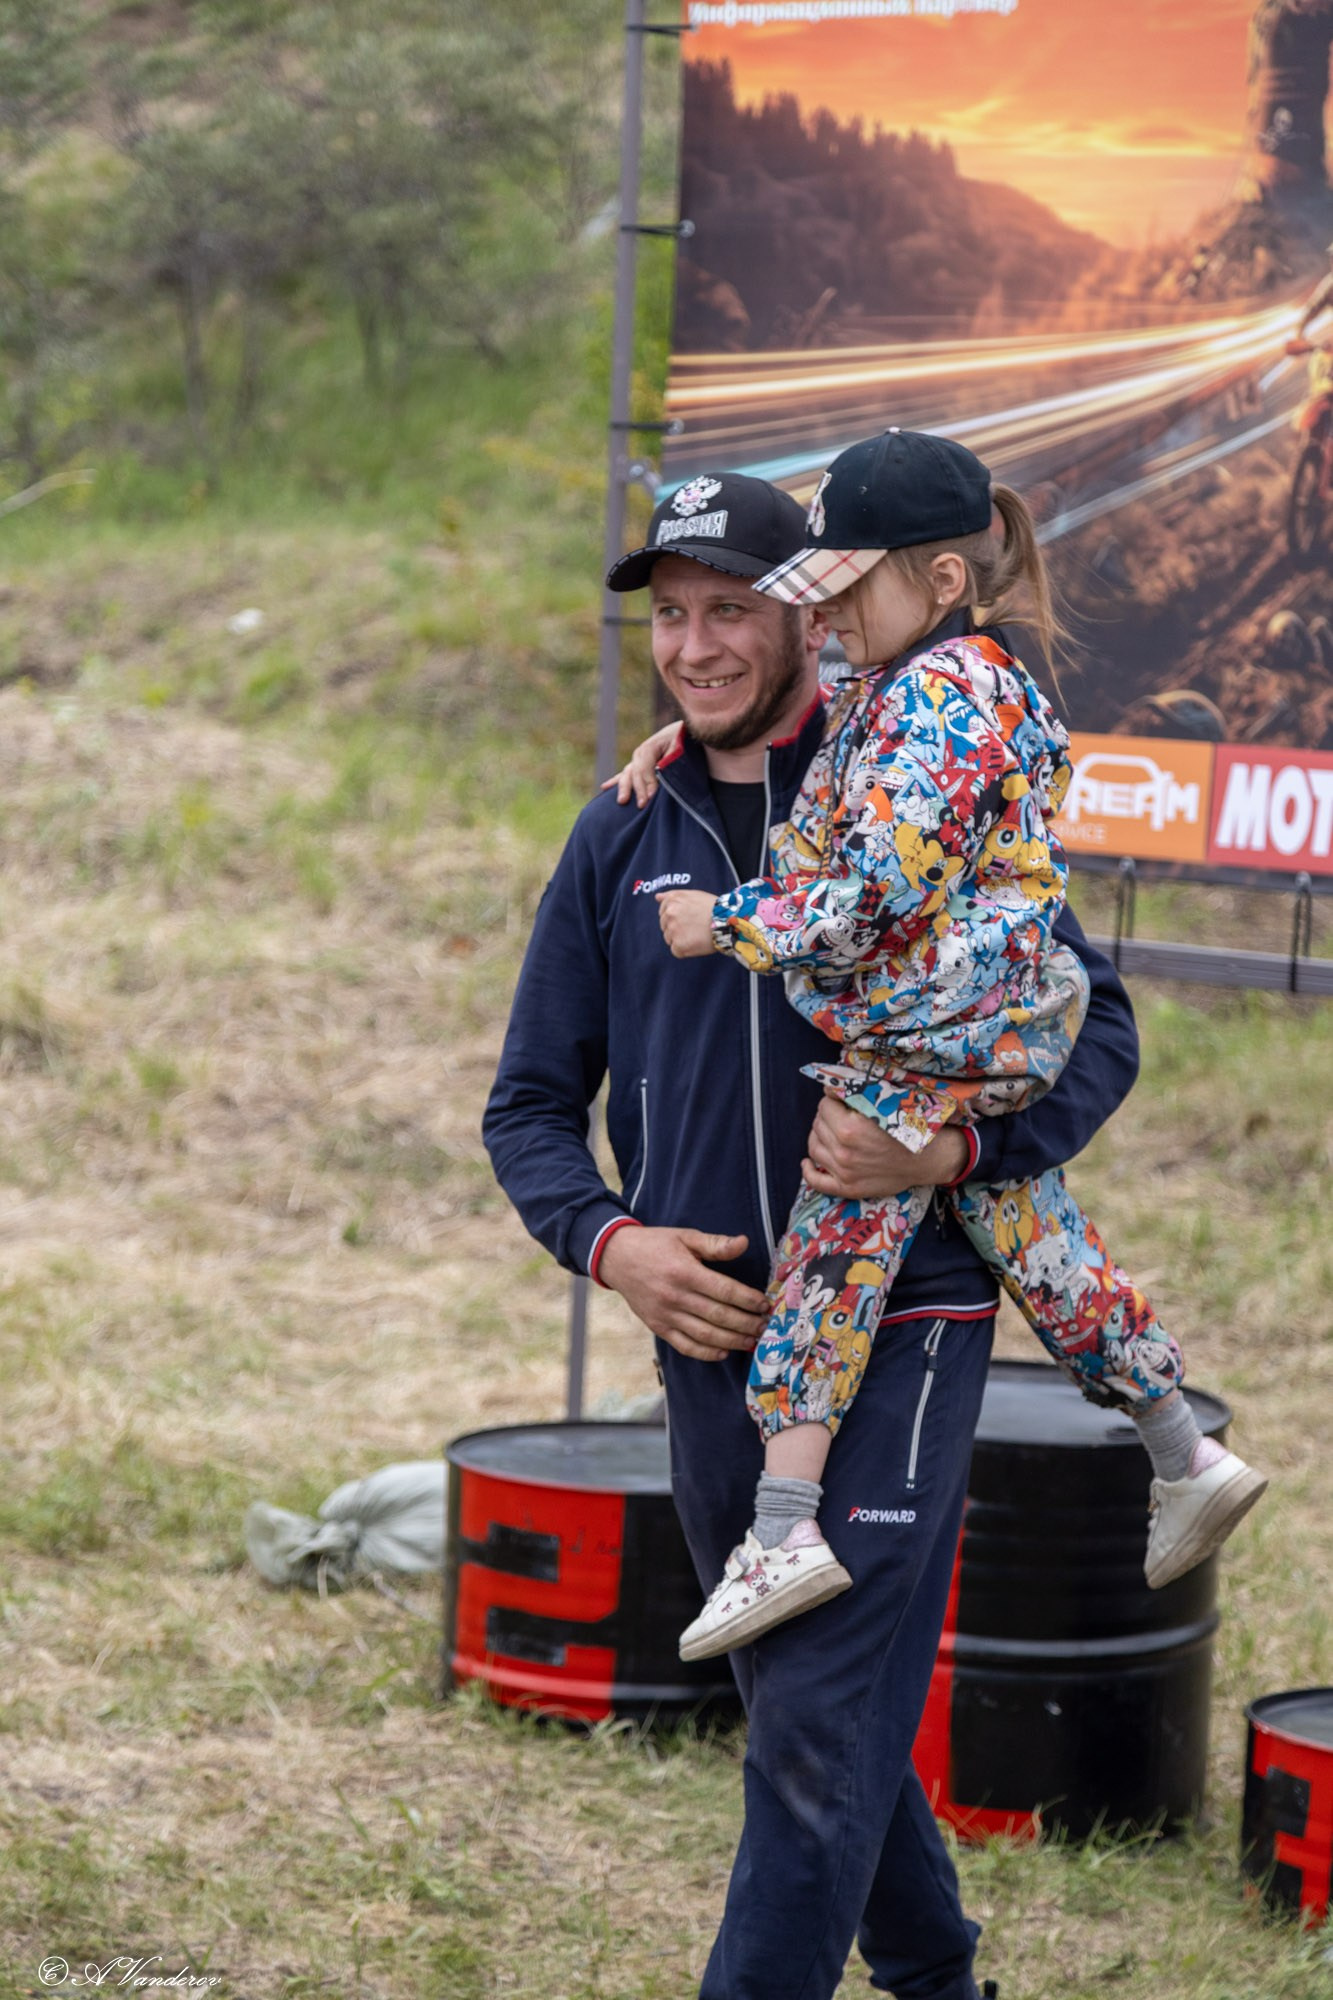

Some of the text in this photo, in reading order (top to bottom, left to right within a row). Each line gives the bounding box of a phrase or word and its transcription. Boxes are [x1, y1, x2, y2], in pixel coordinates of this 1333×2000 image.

[1062, 772, 1199, 830] REAM
[632, 873, 692, 895] FORWARD
[848, 1506, 917, 1523] FORWARD
